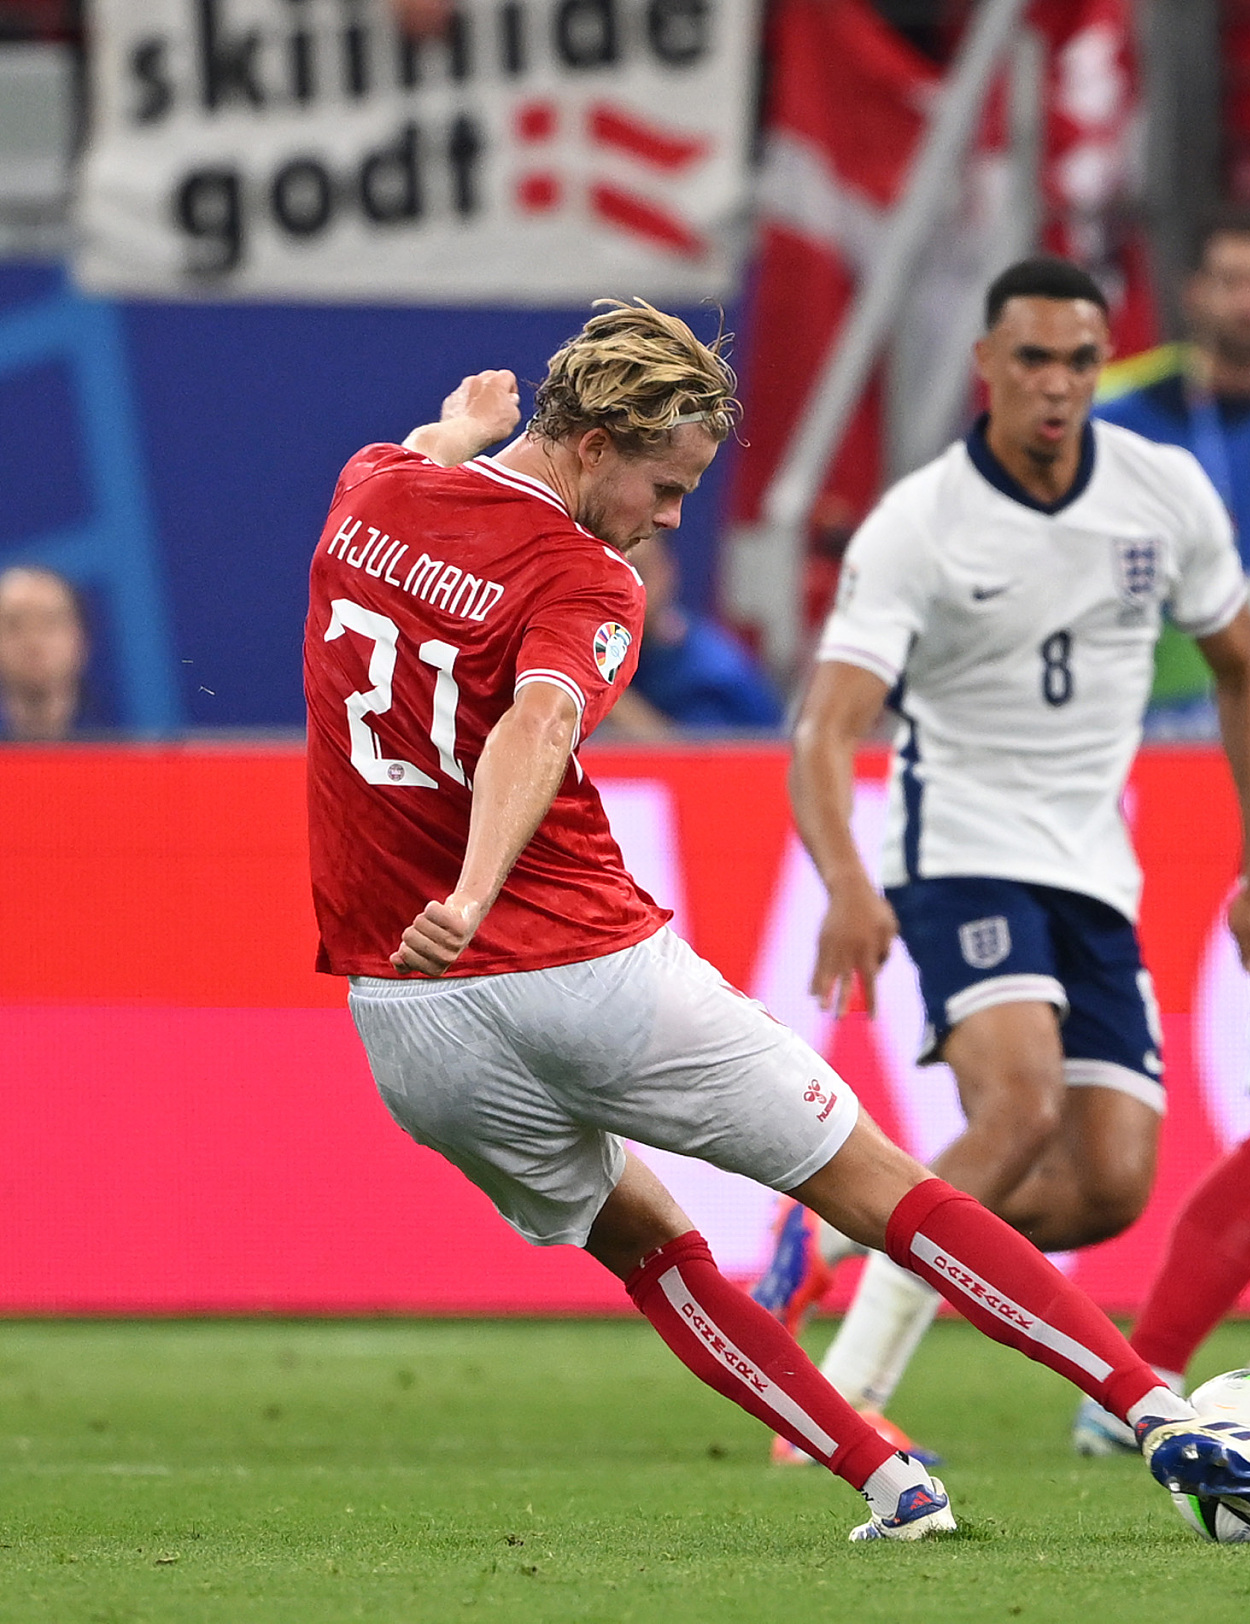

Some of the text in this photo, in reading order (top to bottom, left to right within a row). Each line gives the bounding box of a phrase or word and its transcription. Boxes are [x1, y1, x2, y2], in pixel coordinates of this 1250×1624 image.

[172, 109, 483, 278] godt
[327, 515, 505, 622] HJULMAND
[323, 598, 474, 792] 21
[1041, 628, 1073, 707] 8
[933, 1255, 1035, 1331] DANMARK
[681, 1302, 769, 1394] DANMARK
